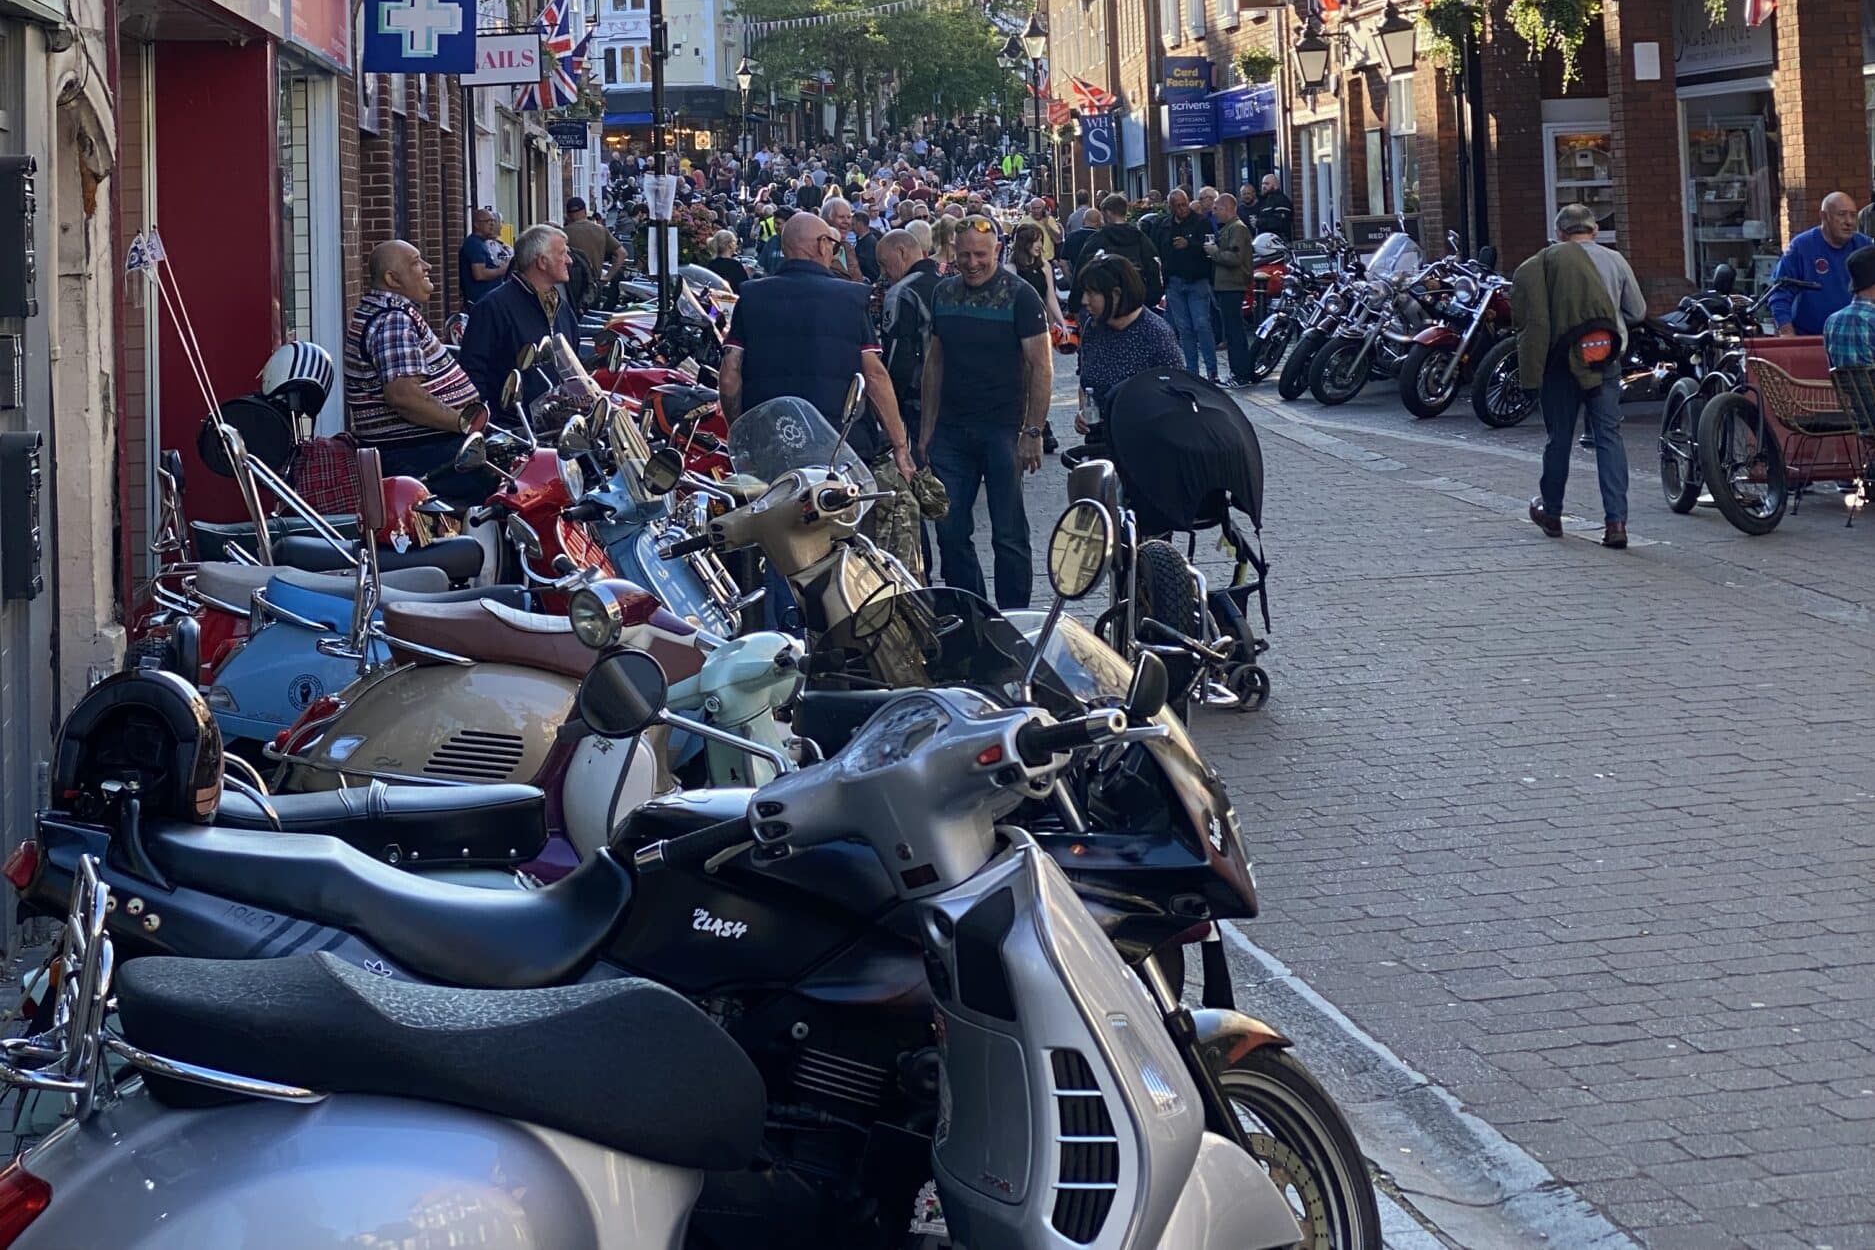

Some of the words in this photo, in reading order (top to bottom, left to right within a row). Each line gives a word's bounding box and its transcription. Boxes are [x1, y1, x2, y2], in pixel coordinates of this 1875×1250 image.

[477, 49, 534, 70] AILS
[1173, 68, 1199, 77] Card
[1166, 77, 1206, 88] Factory
[1171, 100, 1211, 111] scrivens
[1087, 117, 1108, 128] WH
[1088, 128, 1111, 163] S
[693, 911, 748, 939] CLASH
